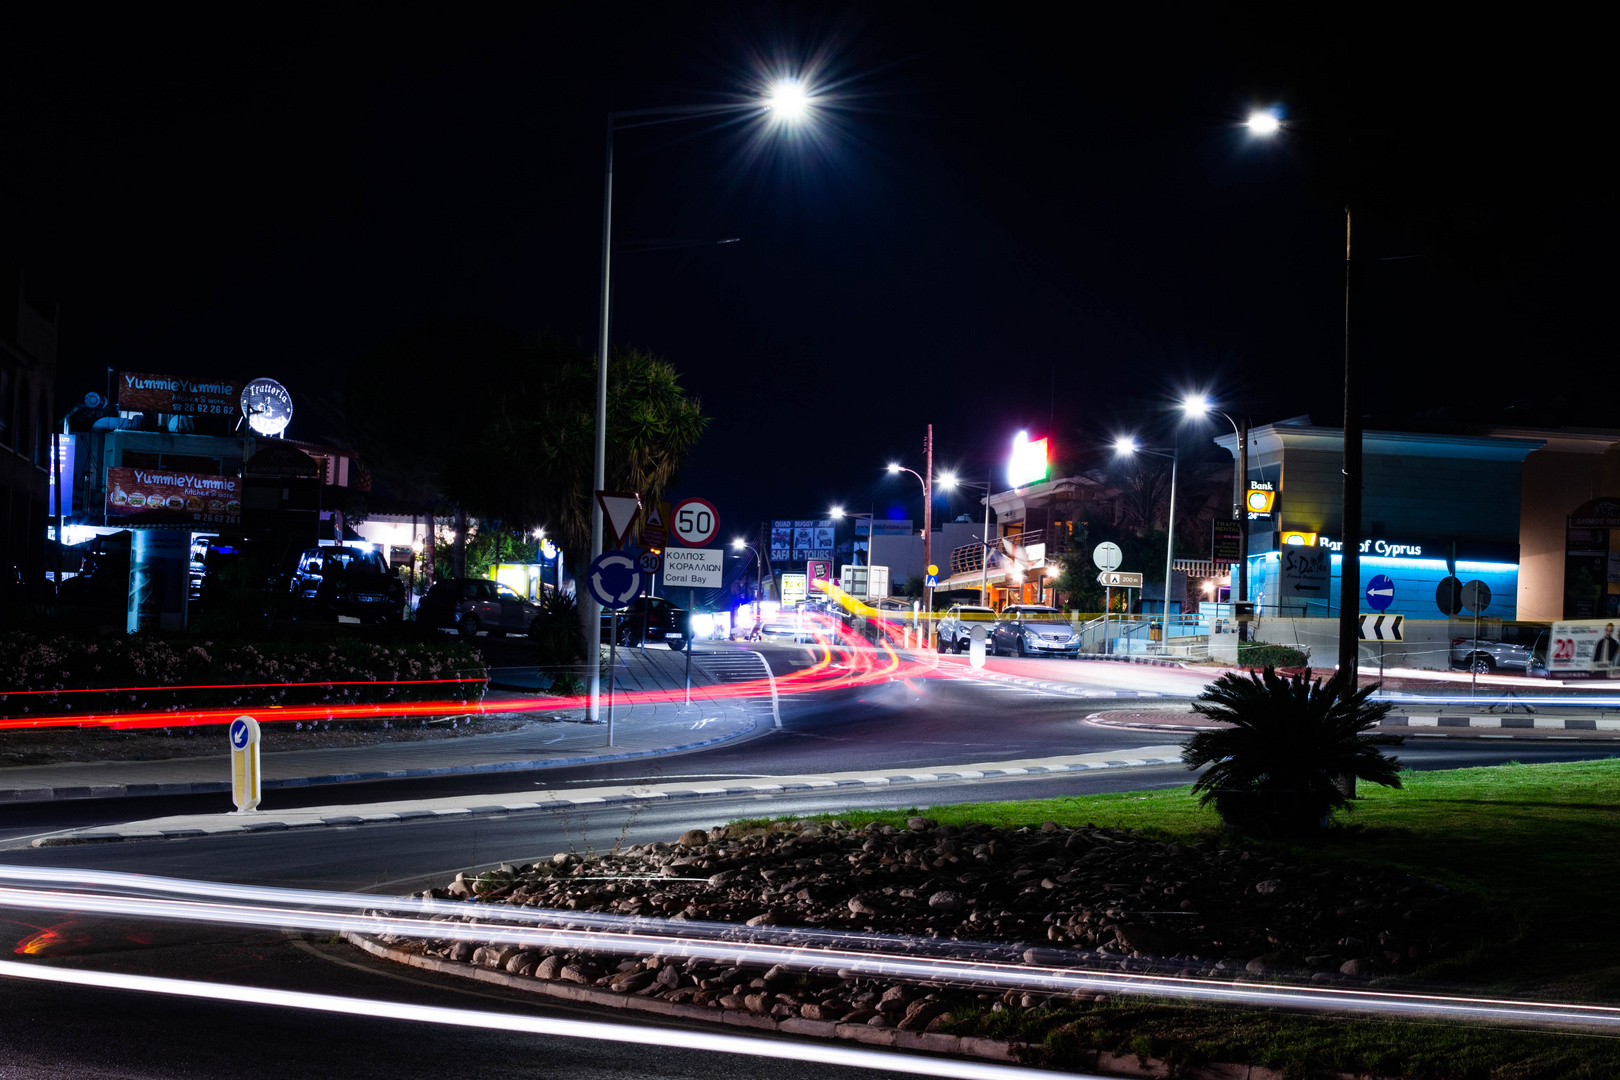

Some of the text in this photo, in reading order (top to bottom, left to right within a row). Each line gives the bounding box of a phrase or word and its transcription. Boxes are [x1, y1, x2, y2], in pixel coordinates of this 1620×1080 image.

[250, 384, 288, 404] Trattoria
[184, 403, 234, 415] 26 62 26 62
[1251, 481, 1273, 490] Bank
[184, 487, 209, 496] Kitchen
[679, 510, 711, 533] 50
[1375, 540, 1422, 557] Cyprus
[666, 552, 706, 561] ΚΟΛΠΟΣ
[771, 549, 798, 560] SAFARI
[803, 549, 830, 560] TOURS
[641, 556, 658, 569] 30
[669, 562, 721, 572] ΚΟΡΑΛΛΙΩΝ
[665, 573, 707, 584] Coral Bay
[784, 580, 804, 588] TAXI
